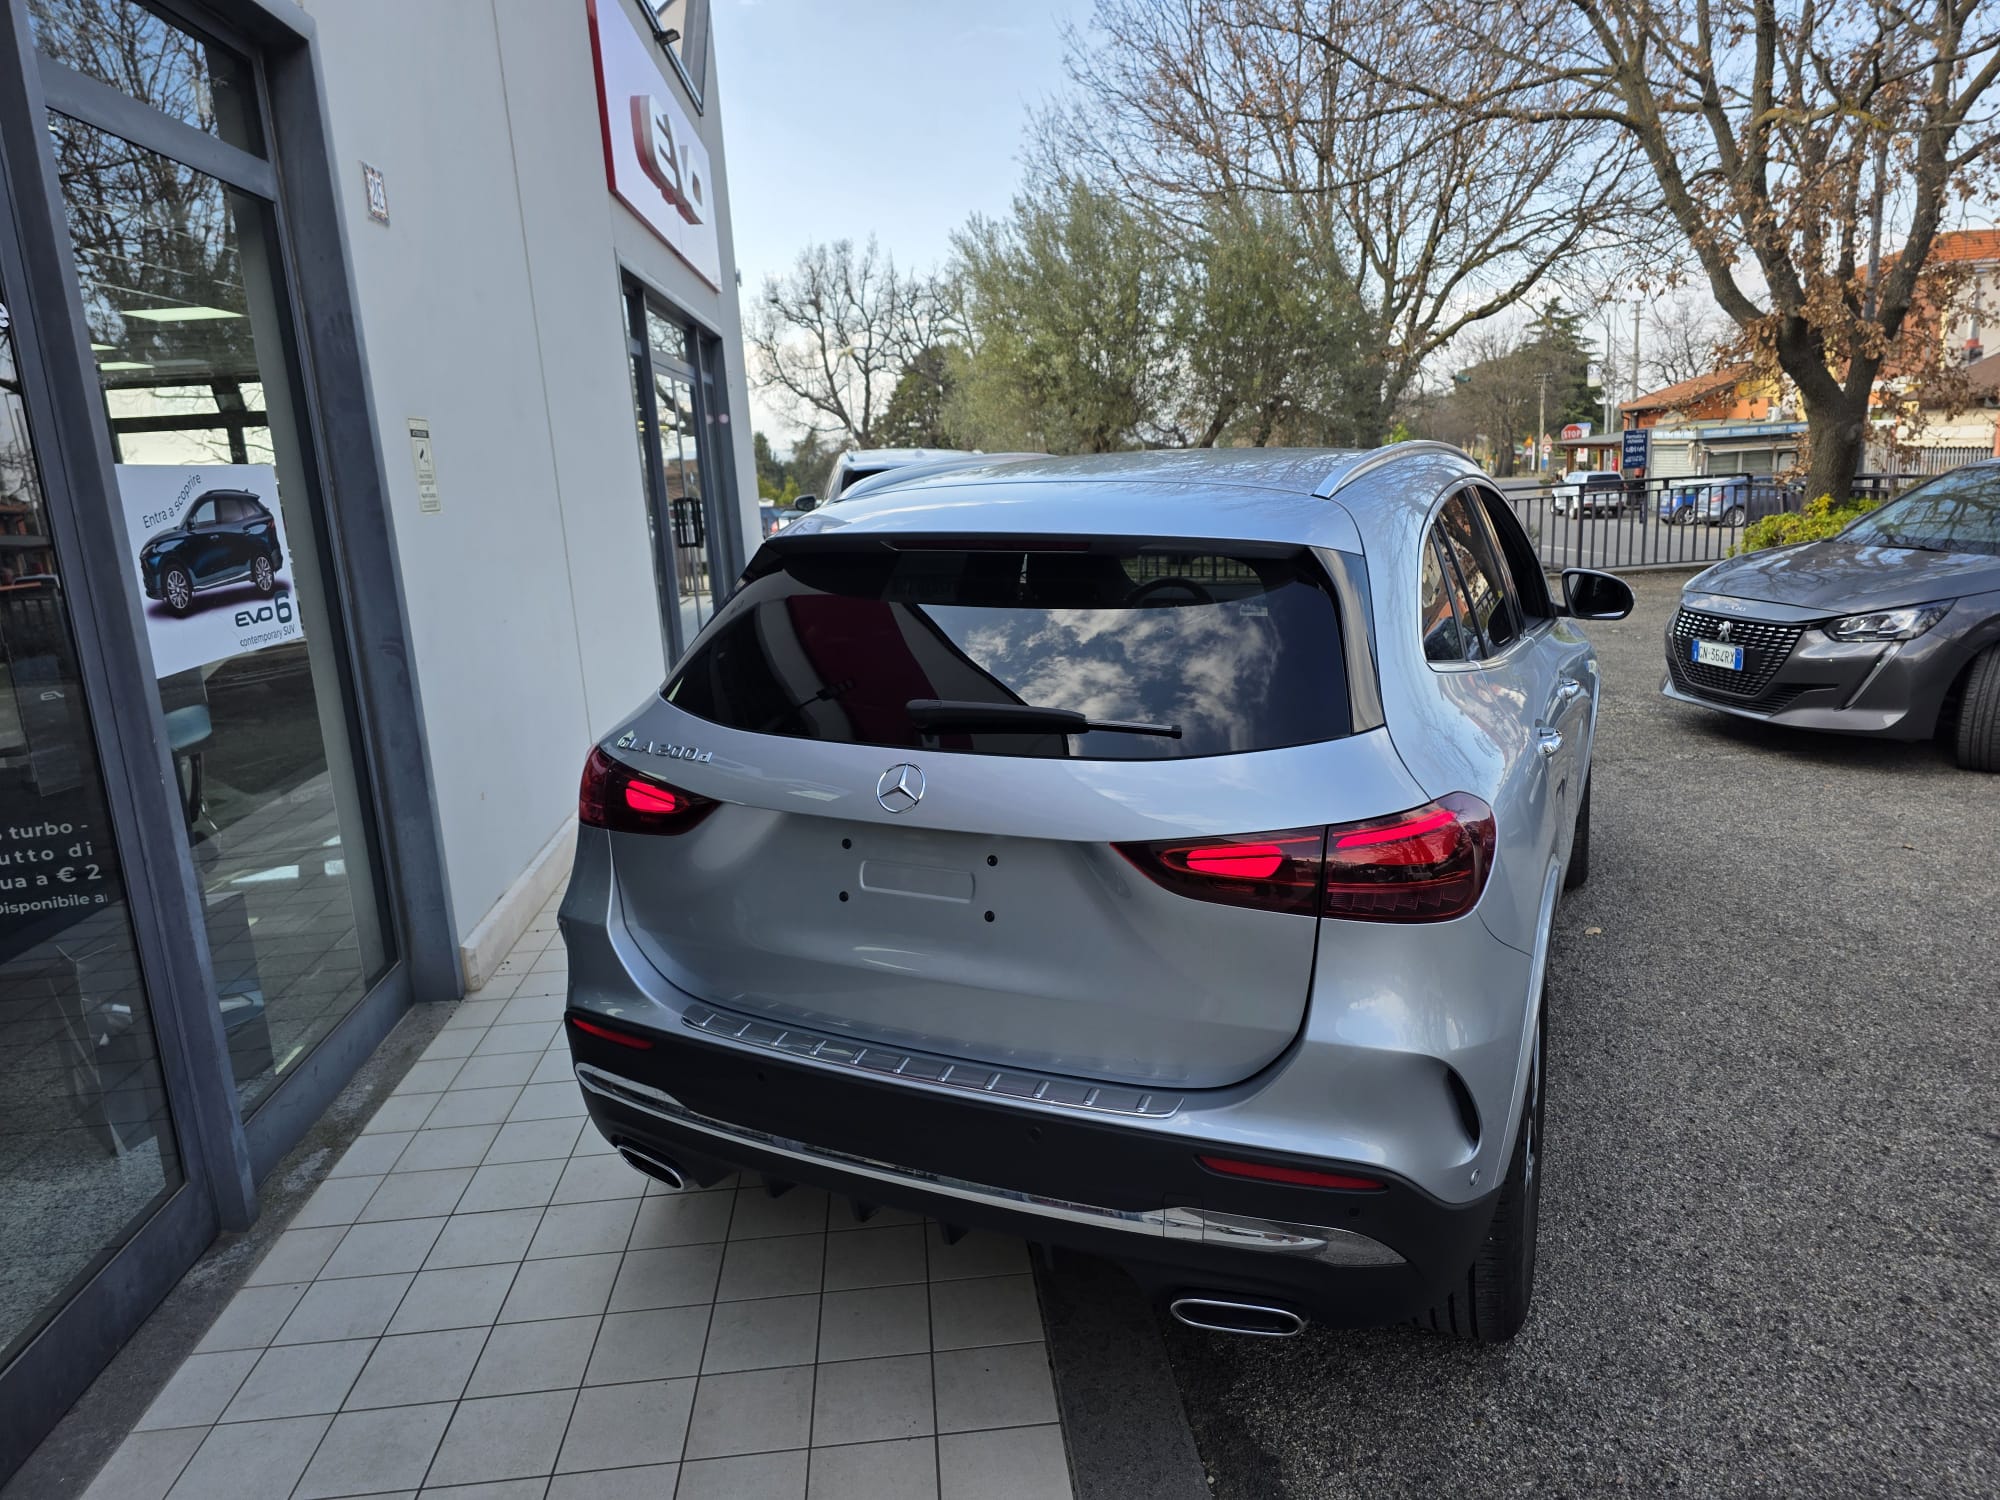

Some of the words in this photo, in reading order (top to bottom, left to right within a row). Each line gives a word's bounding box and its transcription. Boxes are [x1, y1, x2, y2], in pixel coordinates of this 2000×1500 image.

[1563, 430, 1581, 439] STOP
[142, 510, 168, 529] Entra
[169, 507, 175, 517] a
[174, 473, 202, 513] scoprire
[239, 629, 283, 648] contemporary
[283, 624, 296, 636] SUV
[9, 821, 73, 839] turbo
[68, 841, 93, 857] di
[35, 874, 48, 886] a
